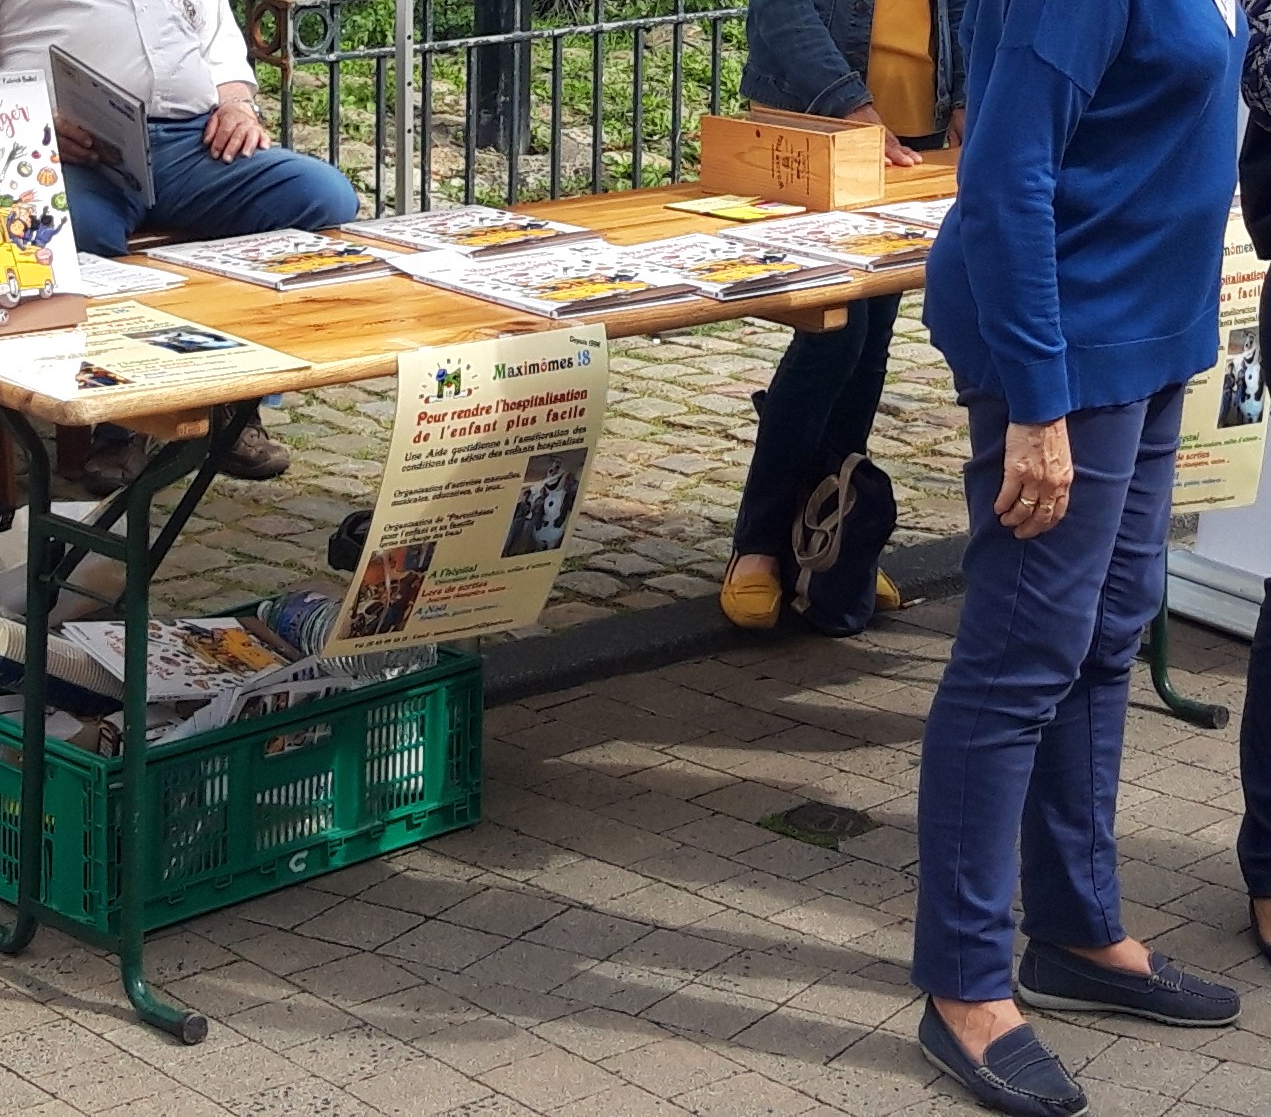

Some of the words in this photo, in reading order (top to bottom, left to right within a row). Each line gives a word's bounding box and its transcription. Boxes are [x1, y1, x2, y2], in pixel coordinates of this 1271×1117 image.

[492, 357, 573, 381] Maximômes
[413, 431, 430, 444] de
[439, 419, 497, 440] l'enfant
[506, 413, 537, 432] plus
[545, 405, 586, 423] facile
[416, 410, 448, 427] Pour
[450, 403, 492, 421] rendre
[494, 387, 588, 414] l'hospitalisation
